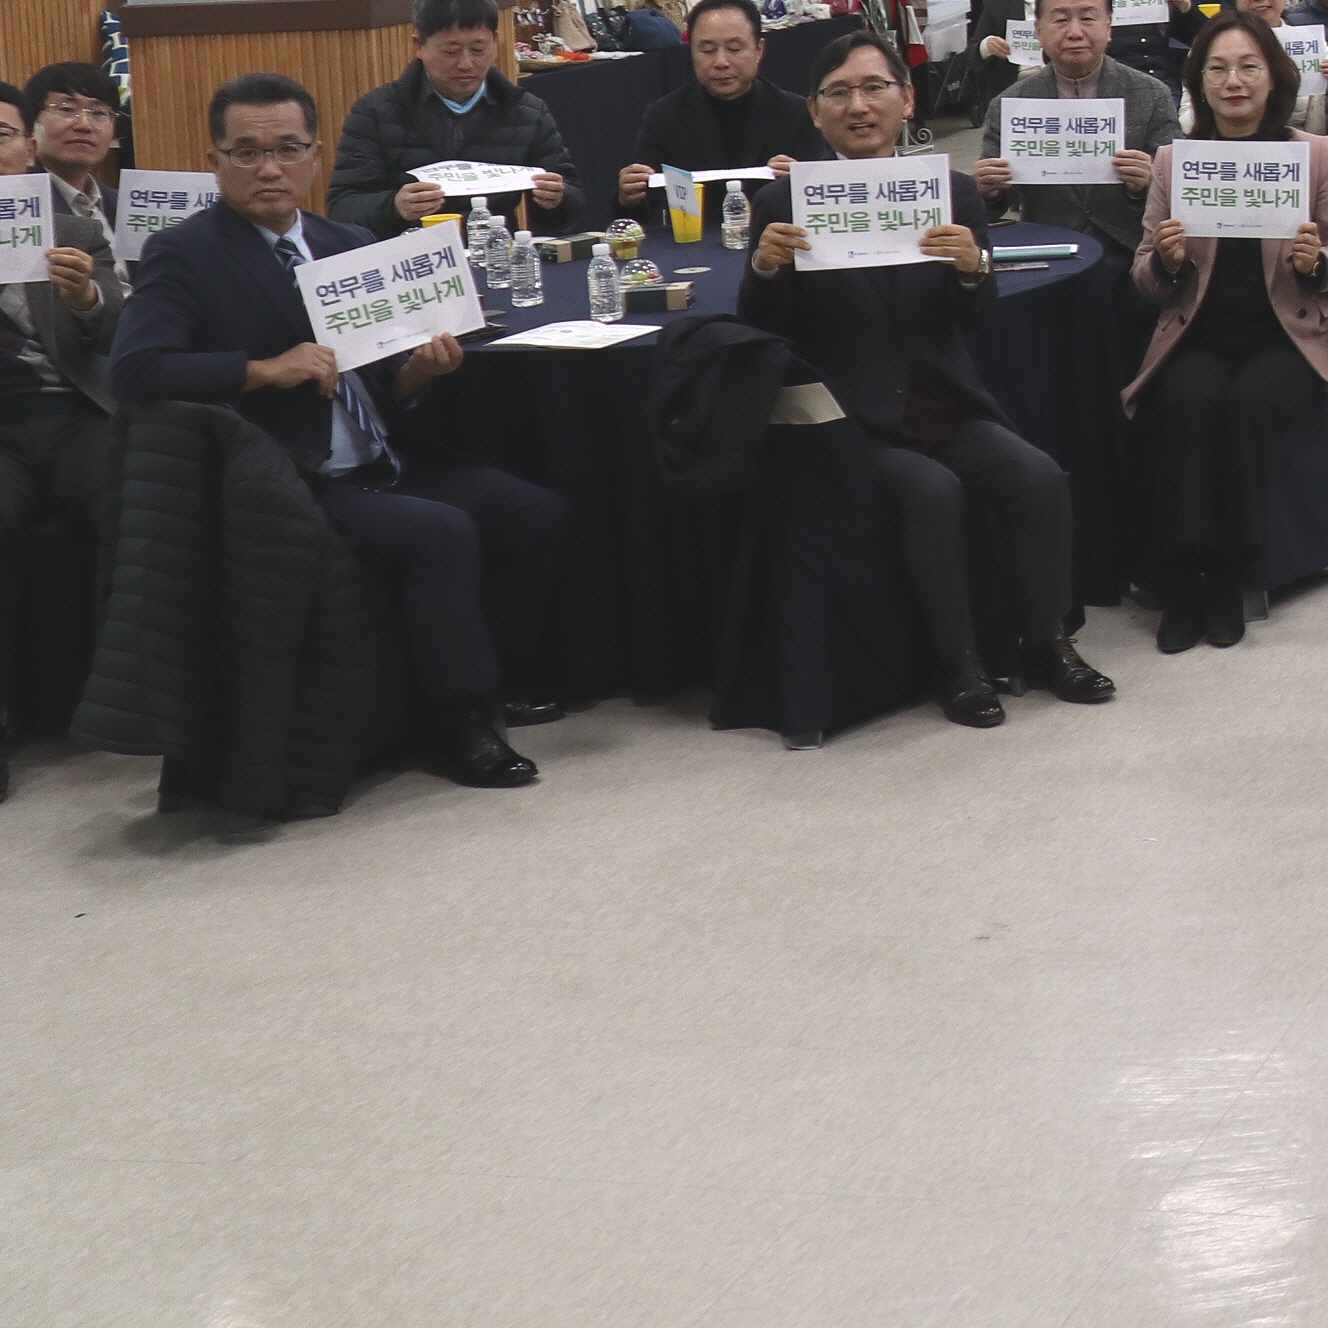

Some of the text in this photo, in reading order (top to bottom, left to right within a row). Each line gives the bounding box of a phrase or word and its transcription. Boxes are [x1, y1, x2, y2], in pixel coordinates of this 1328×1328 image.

[1009, 114, 1117, 135] 연무를 새롭게
[1009, 138, 1117, 158] 주민을 빛나게
[1182, 160, 1300, 183] 연무를 새롭게
[129, 189, 190, 211] 연무를
[803, 176, 941, 206] 연무를 새롭게
[1180, 186, 1300, 210] 주민을 빛나게
[804, 206, 942, 233] 주민을 빛나게
[315, 245, 457, 308] 연무를 새롭게
[324, 273, 465, 336] 주민을 빛나게
